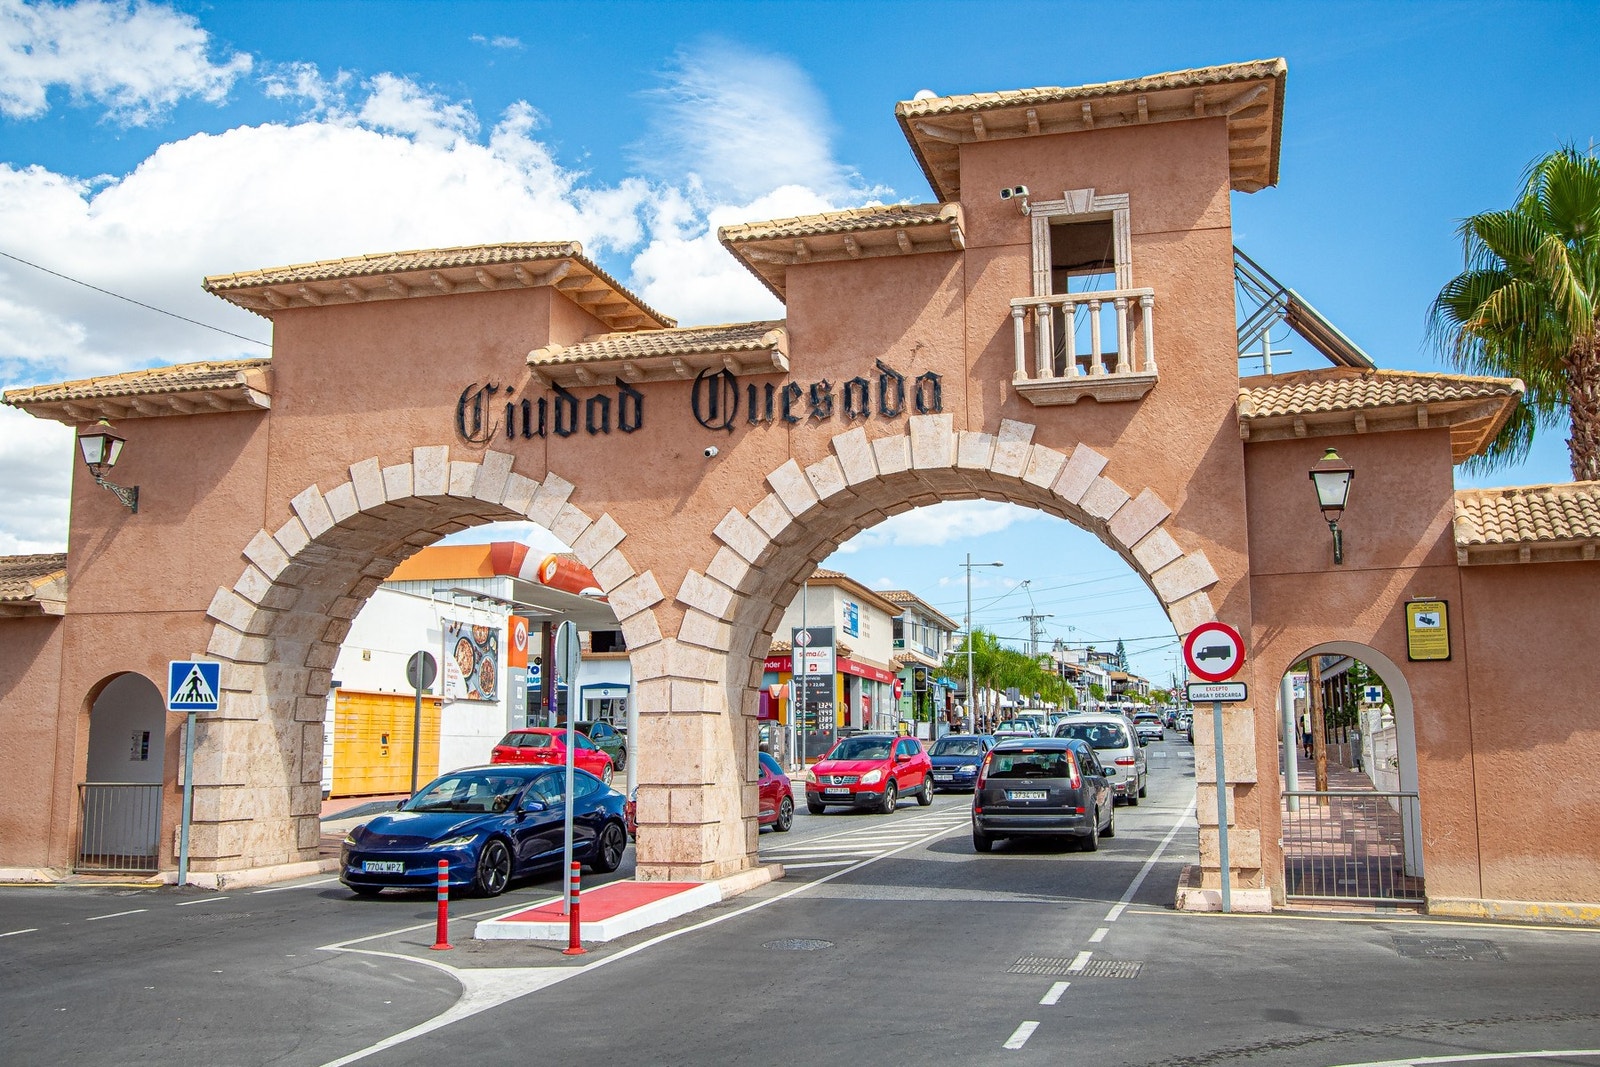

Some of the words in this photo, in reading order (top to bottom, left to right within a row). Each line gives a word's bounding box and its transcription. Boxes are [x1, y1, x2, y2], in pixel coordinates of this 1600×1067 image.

[456, 377, 645, 444] Ciudad
[692, 358, 943, 434] Quesada
[366, 863, 384, 871] 7704
[386, 863, 402, 871] MPZ
